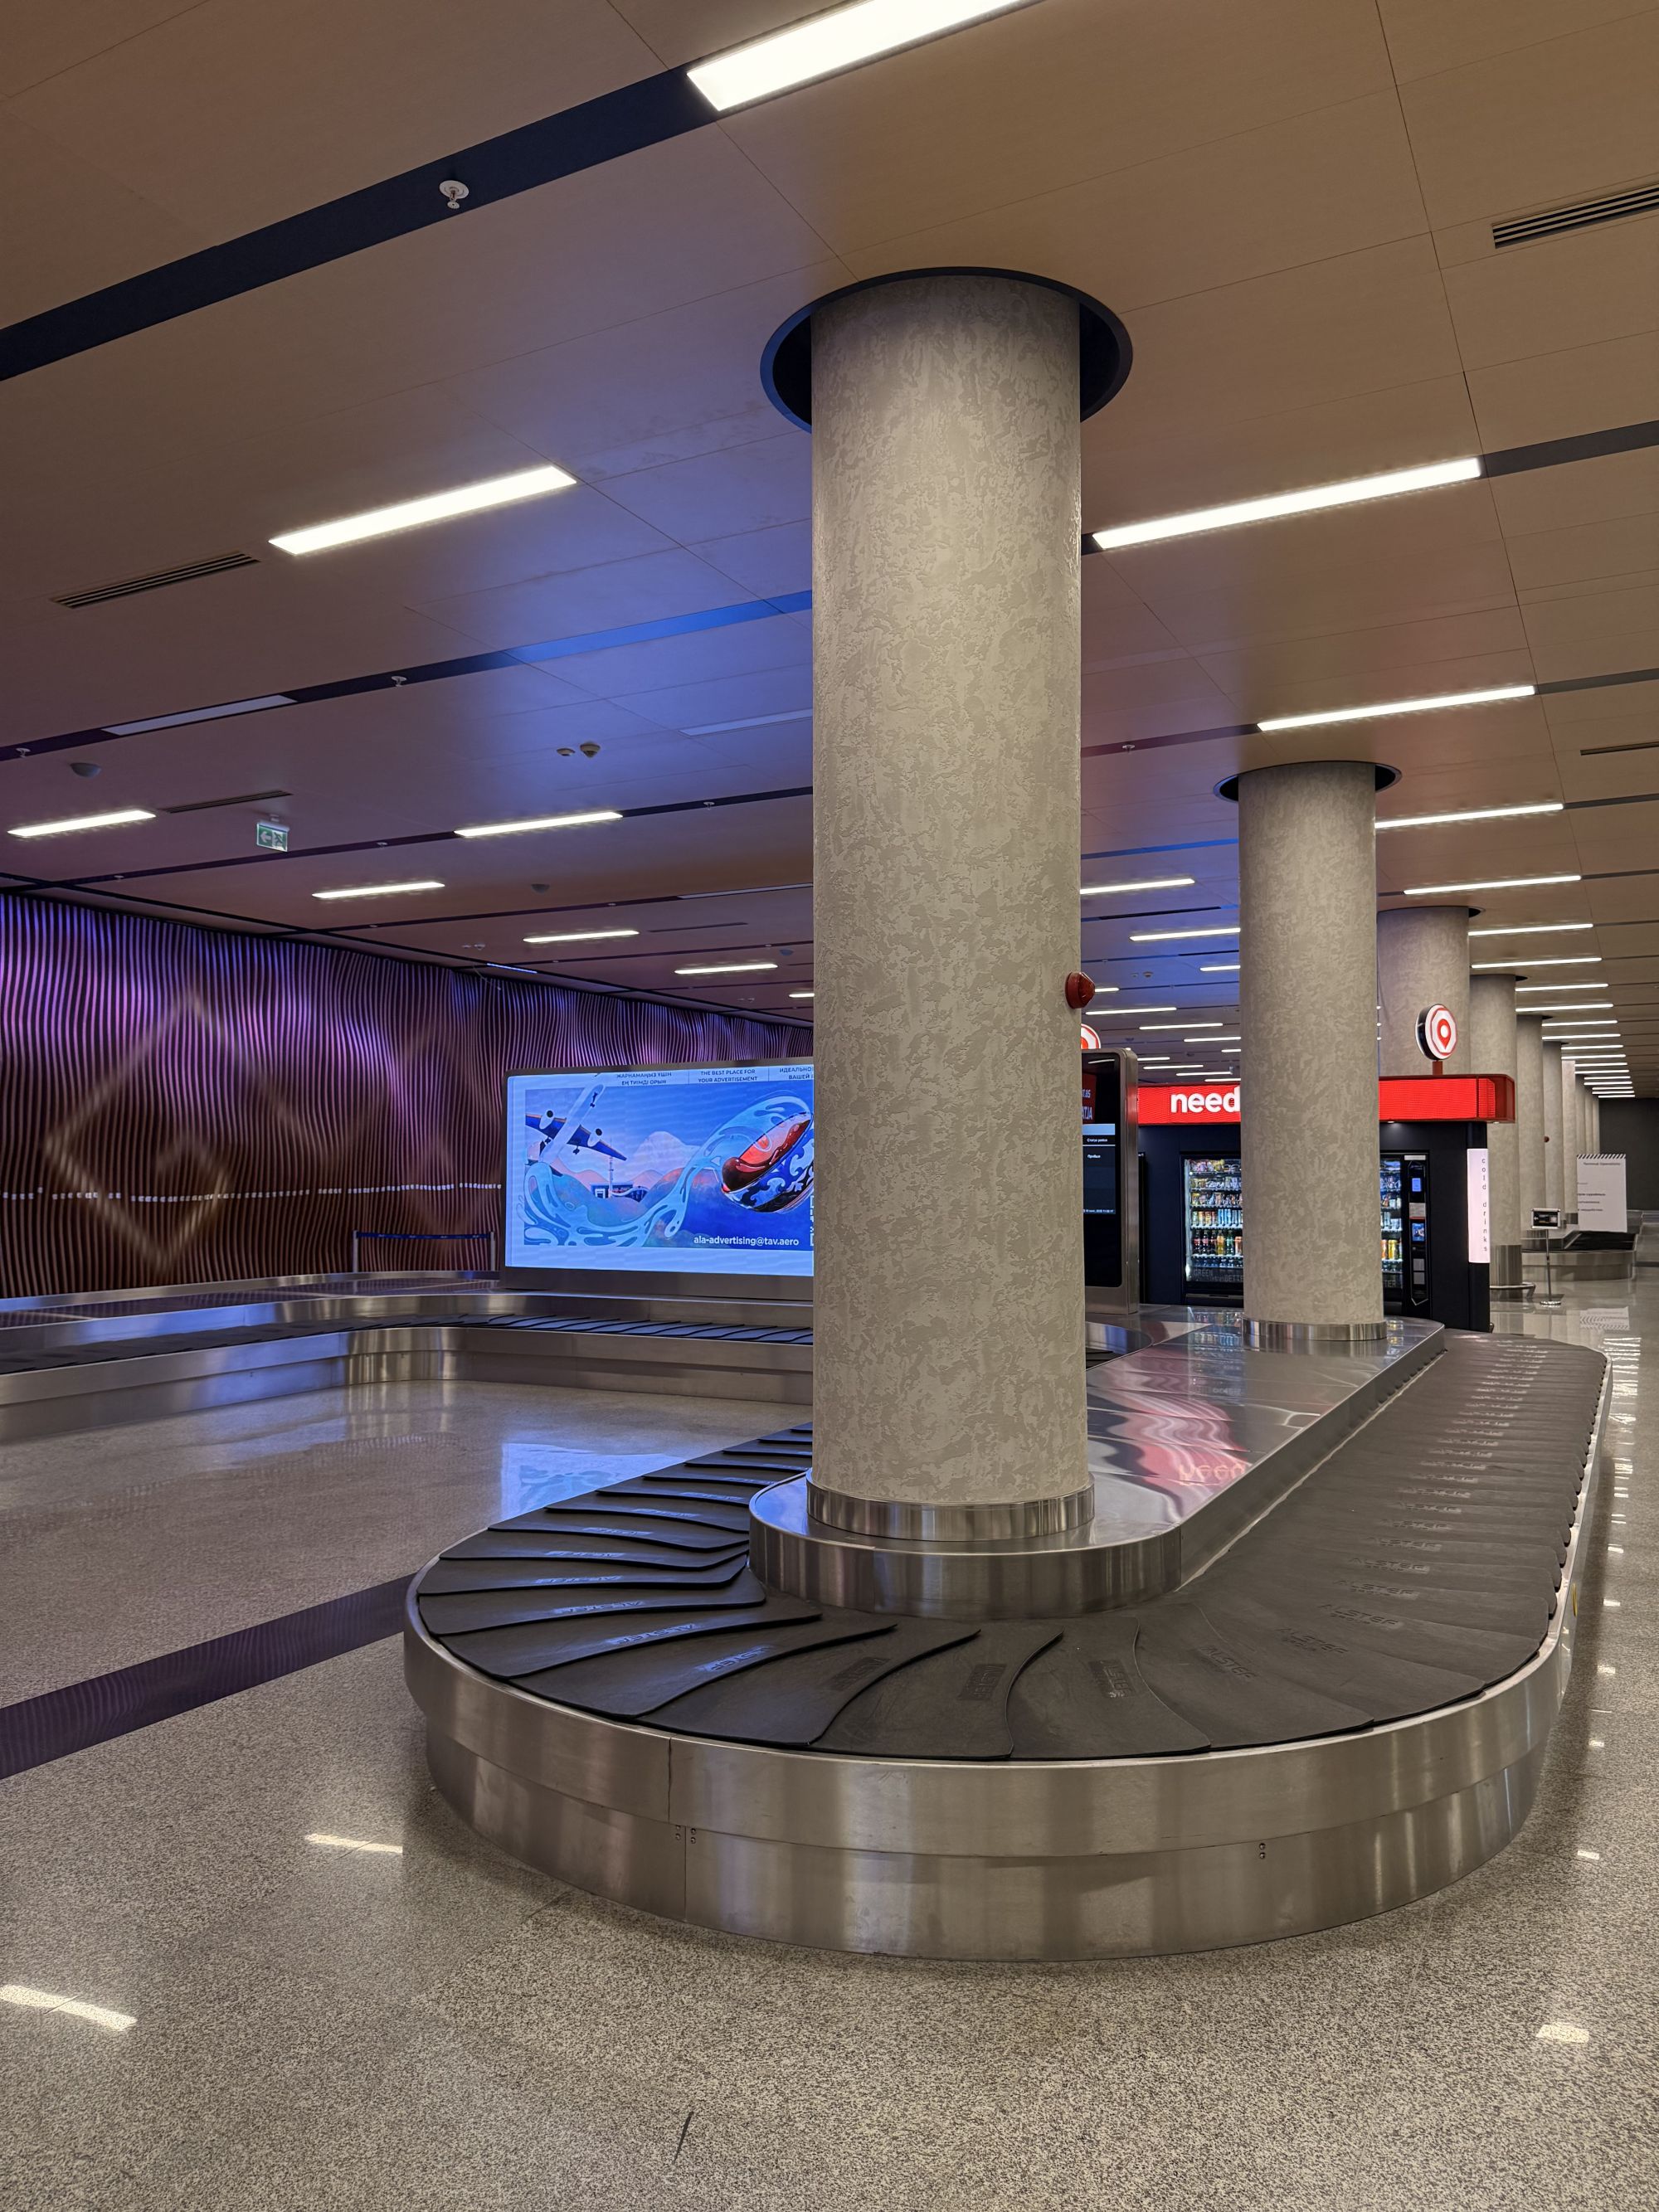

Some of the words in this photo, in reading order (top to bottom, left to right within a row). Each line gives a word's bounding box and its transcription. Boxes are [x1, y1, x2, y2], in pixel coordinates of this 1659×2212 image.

[1170, 1086, 1241, 1113] need
[693, 1235, 800, 1247] ala-advertising@tav.aero
[1316, 1603, 1399, 1626] ALSTEF
